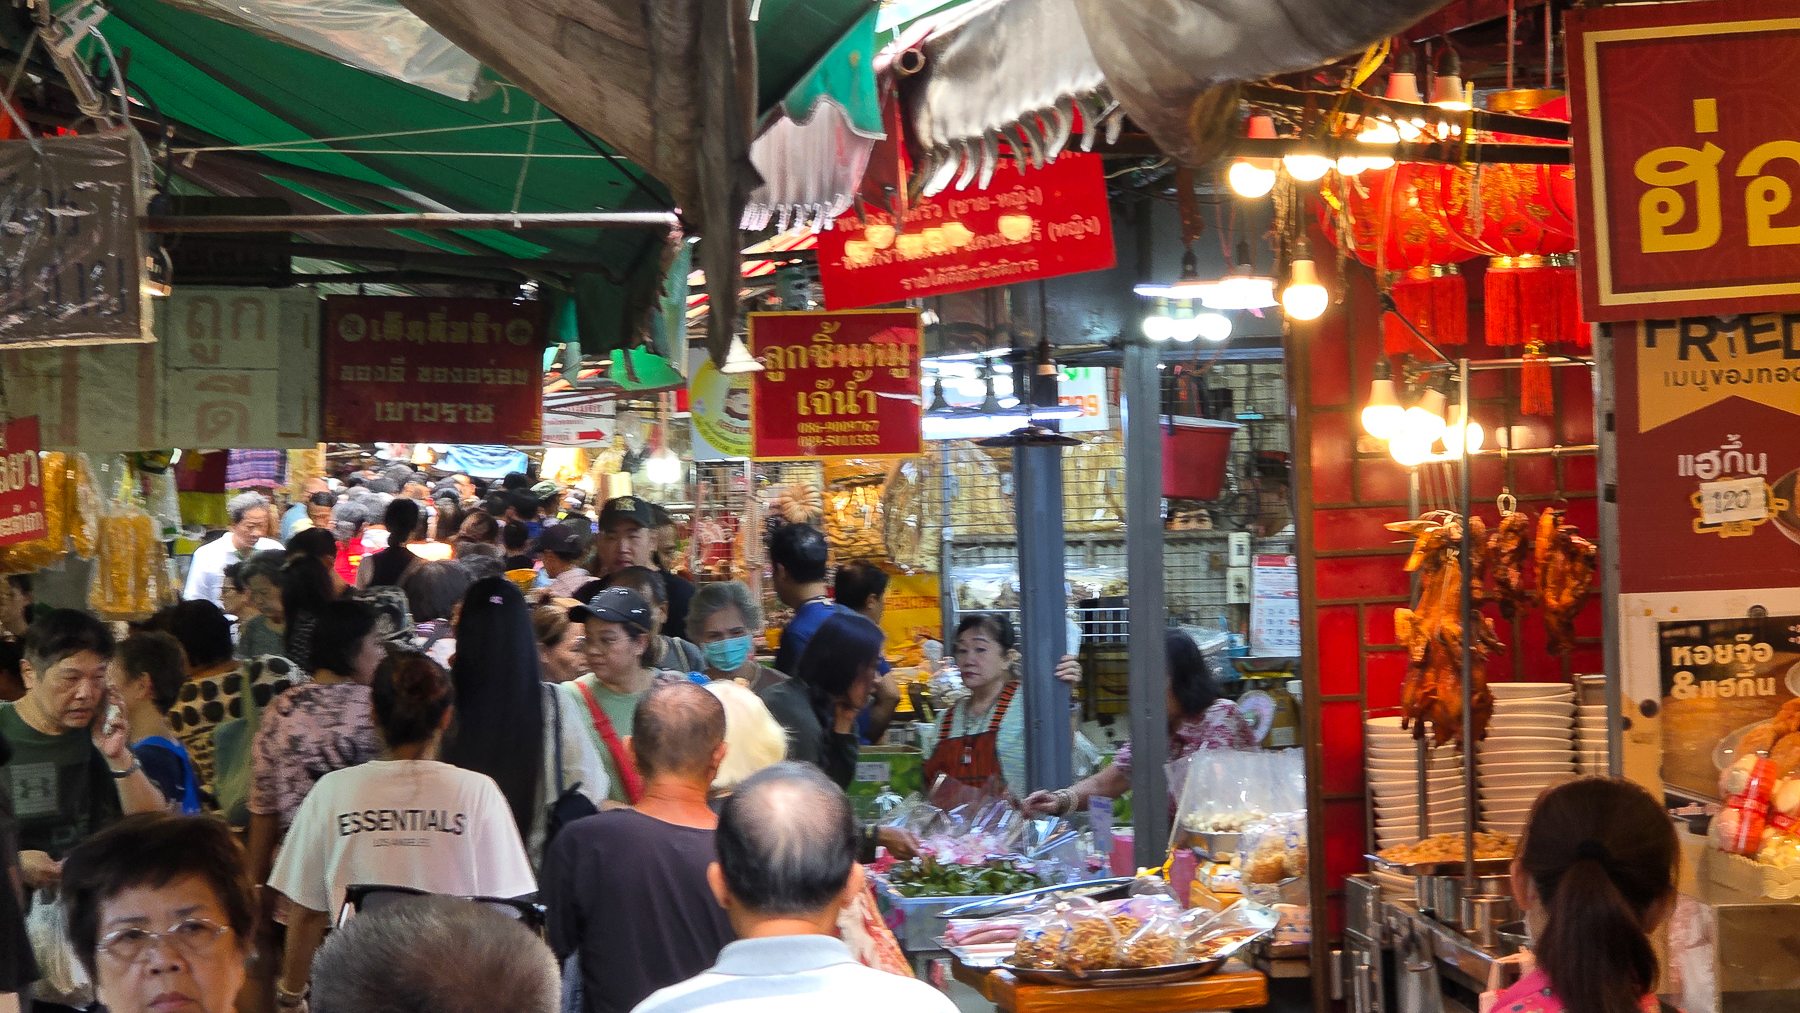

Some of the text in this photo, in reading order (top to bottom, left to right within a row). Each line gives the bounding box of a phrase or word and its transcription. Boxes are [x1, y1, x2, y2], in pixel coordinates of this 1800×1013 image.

[761, 321, 911, 382] ลูกชิ้นหมู
[1712, 489, 1751, 514] 120
[337, 809, 466, 837] ESSENTIALS
